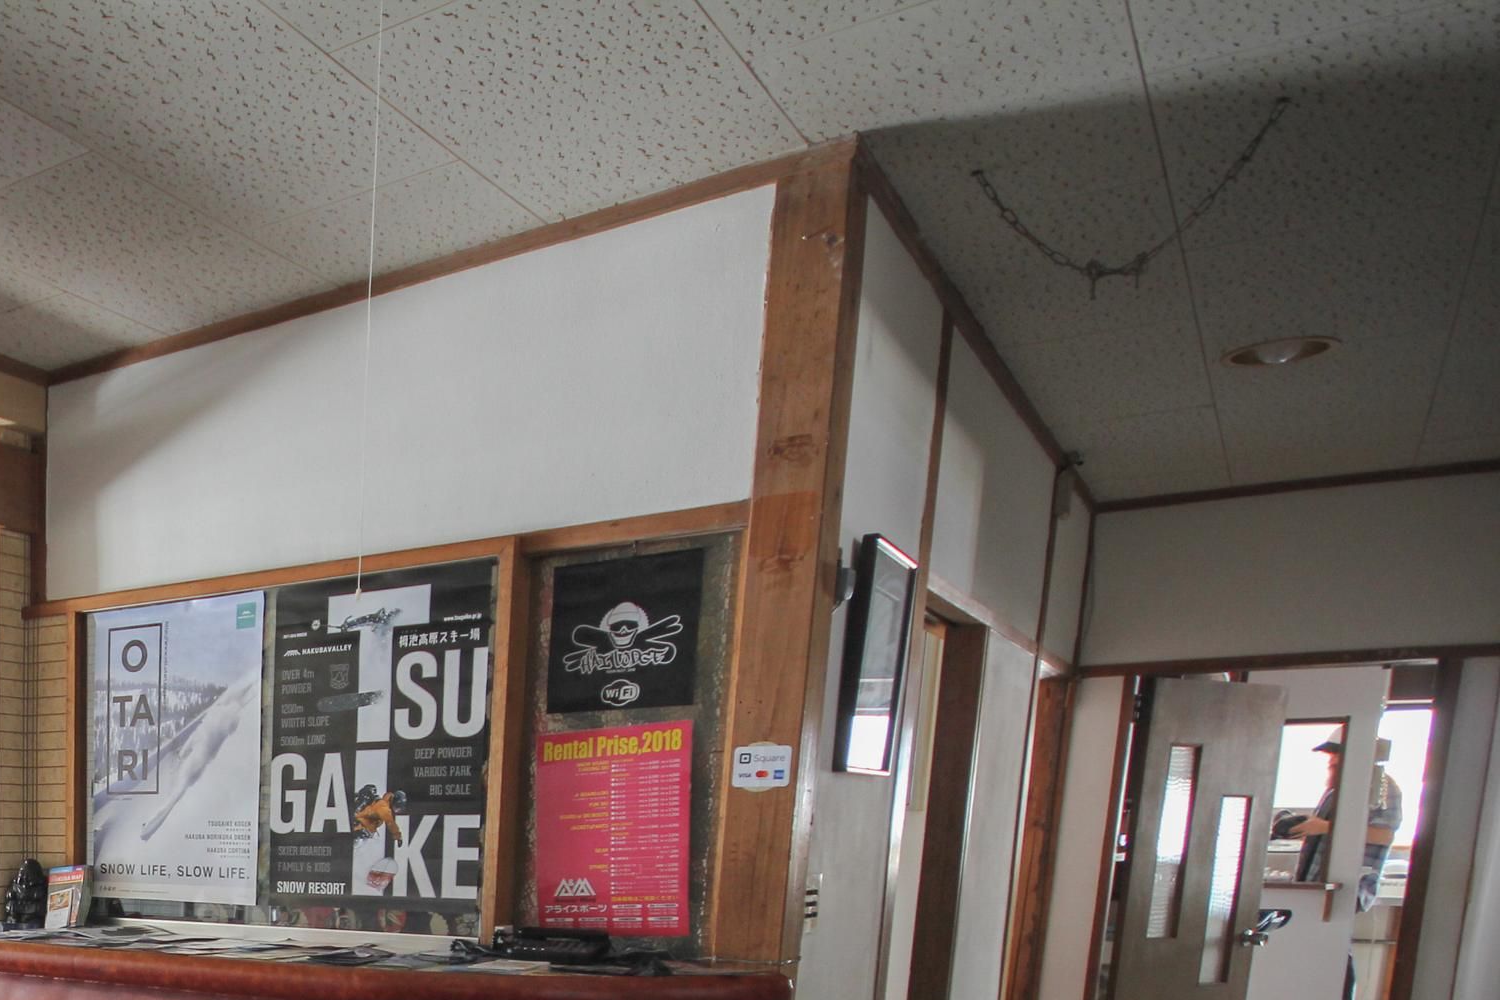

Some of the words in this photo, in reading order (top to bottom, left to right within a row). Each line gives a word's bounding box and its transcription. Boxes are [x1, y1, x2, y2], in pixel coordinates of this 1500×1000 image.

[121, 639, 148, 672] O
[281, 683, 312, 694] POWDER
[113, 694, 155, 727] TA
[414, 748, 435, 760] DEEP
[437, 747, 472, 759] POWDER
[543, 738, 593, 762] Rental
[117, 749, 149, 781] RI
[754, 754, 786, 763] Square
[413, 766, 447, 777] VARIOUS
[450, 765, 472, 777] PARK
[429, 785, 443, 796] BIG
[445, 784, 471, 796] SCALE
[101, 863, 135, 875] SNOW
[140, 865, 171, 878] LIFE,
[177, 865, 213, 878] SLOW
[218, 867, 250, 880] LIFE.
[277, 881, 305, 894] SNOW
[308, 882, 346, 895] RESORT
